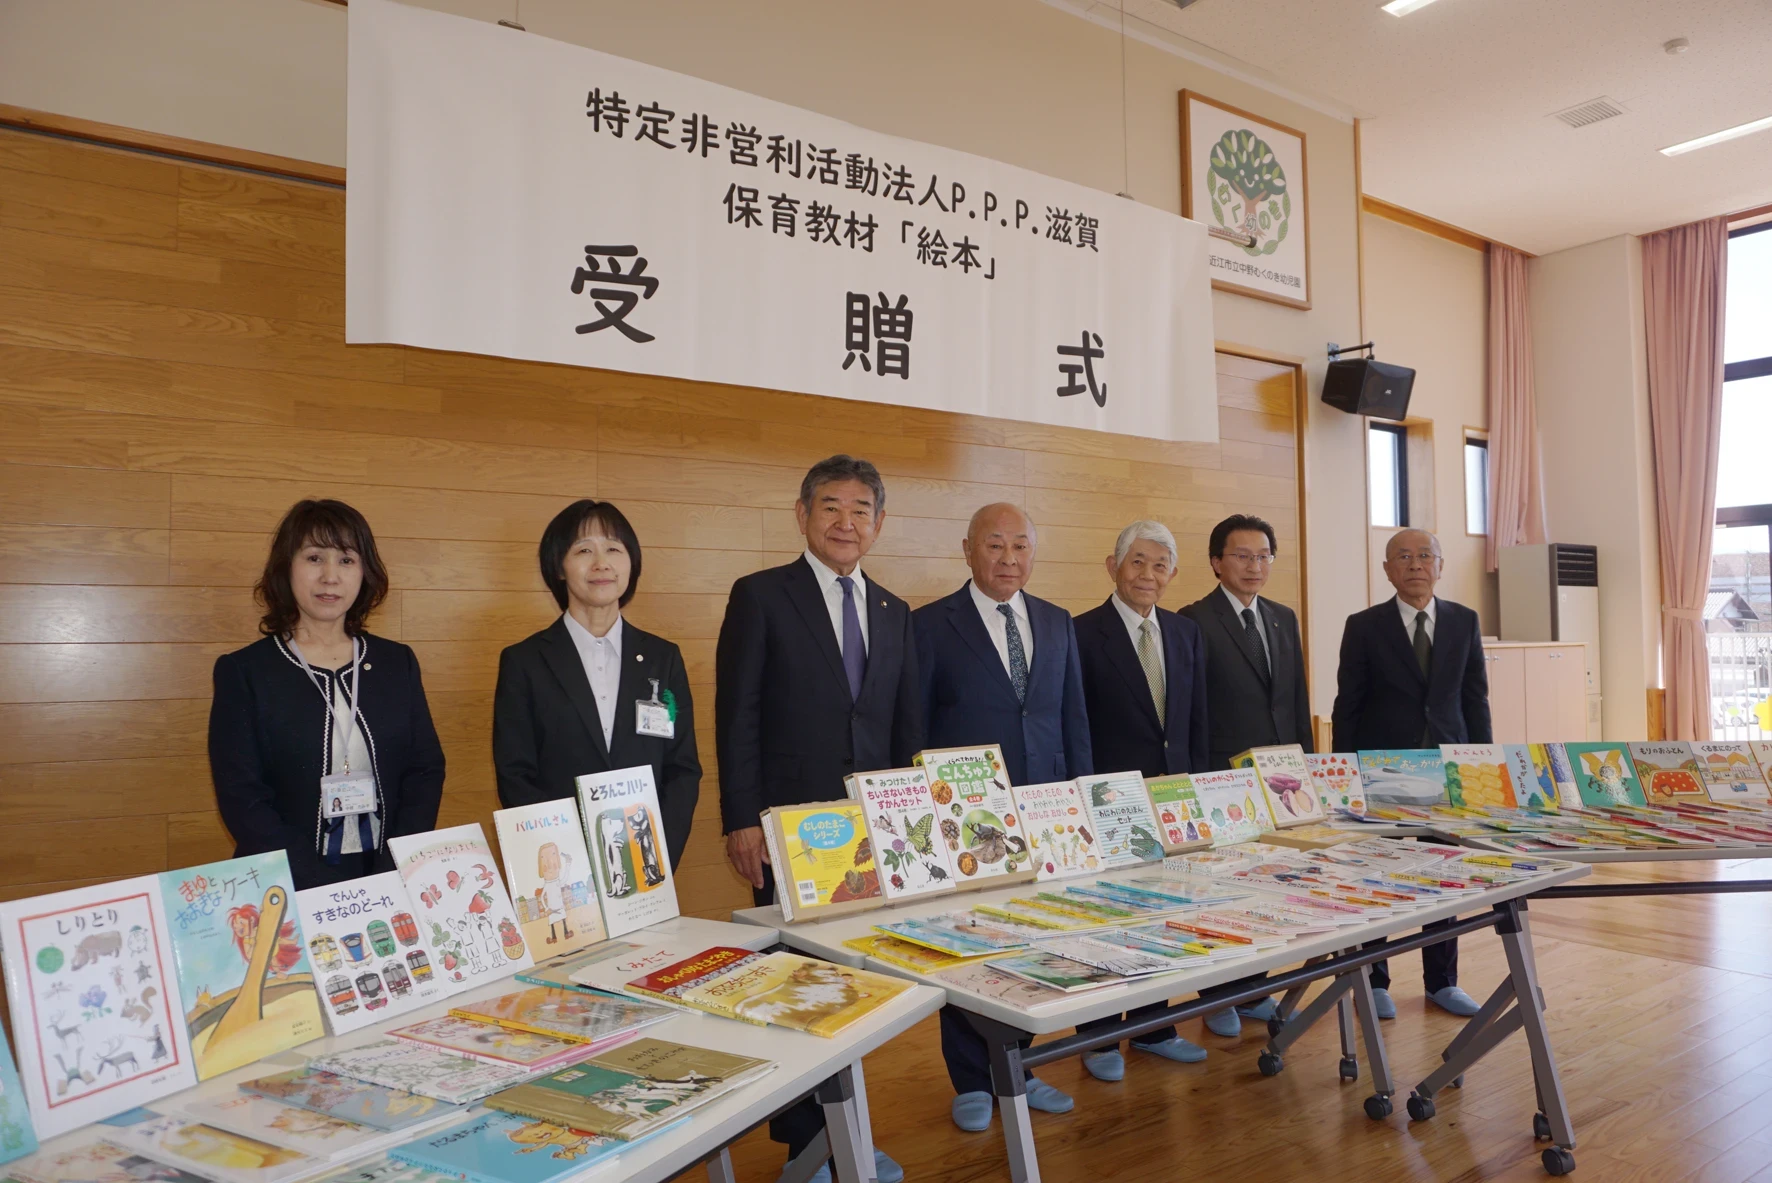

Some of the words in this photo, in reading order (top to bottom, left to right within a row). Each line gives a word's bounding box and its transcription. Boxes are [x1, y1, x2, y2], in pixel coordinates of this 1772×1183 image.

[586, 87, 1099, 252] 特定非営利活動法人P.P.P.滋賀
[723, 183, 996, 280] 保育教材「絵本」
[1639, 747, 1684, 755] もりのおふとん
[1701, 744, 1743, 752] くるまにのって
[942, 762, 992, 780] こんちゅう
[879, 777, 911, 787] みつけた！
[590, 779, 648, 801] どろんこハリー
[867, 786, 928, 800] ちいさないきもの
[877, 796, 922, 810] ずかんセット
[1098, 806, 1144, 818] わにわにのえほん
[516, 814, 568, 832] バルバルさん
[803, 818, 846, 831] むしのたまご
[1117, 816, 1132, 824] セット
[813, 829, 841, 840] シリーズ
[222, 867, 260, 901] ケーキ
[329, 888, 367, 903] でんしゃ
[312, 895, 394, 925] すきなのどーれ
[56, 908, 118, 935] しりとり
[616, 950, 675, 972] くみたて
